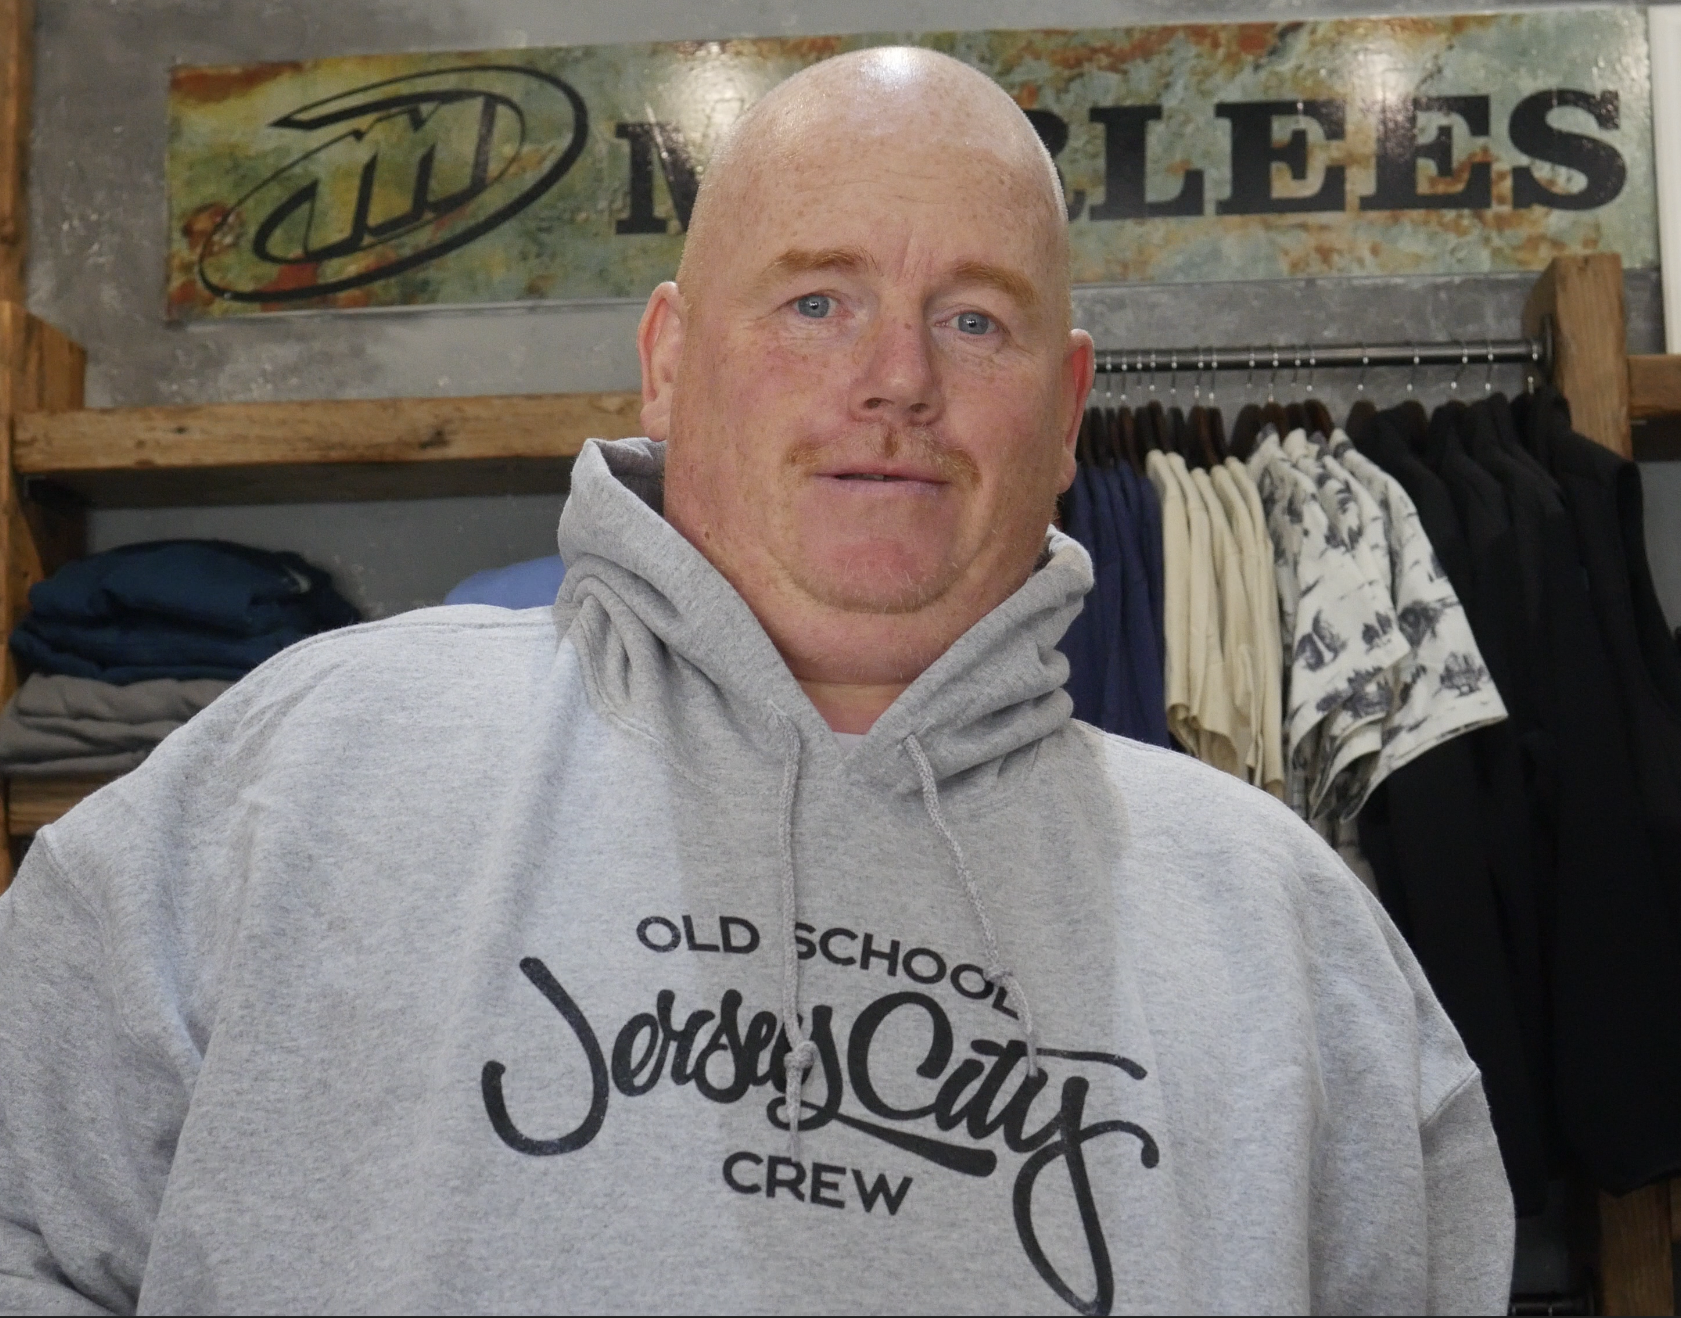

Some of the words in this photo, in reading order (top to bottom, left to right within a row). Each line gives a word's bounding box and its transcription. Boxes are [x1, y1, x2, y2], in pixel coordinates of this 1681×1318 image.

[636, 915, 760, 953] OLD
[794, 922, 1020, 1020] SCHOOL
[481, 957, 844, 1156] Jersey
[848, 991, 1160, 1317] City
[722, 1151, 913, 1216] CREW
